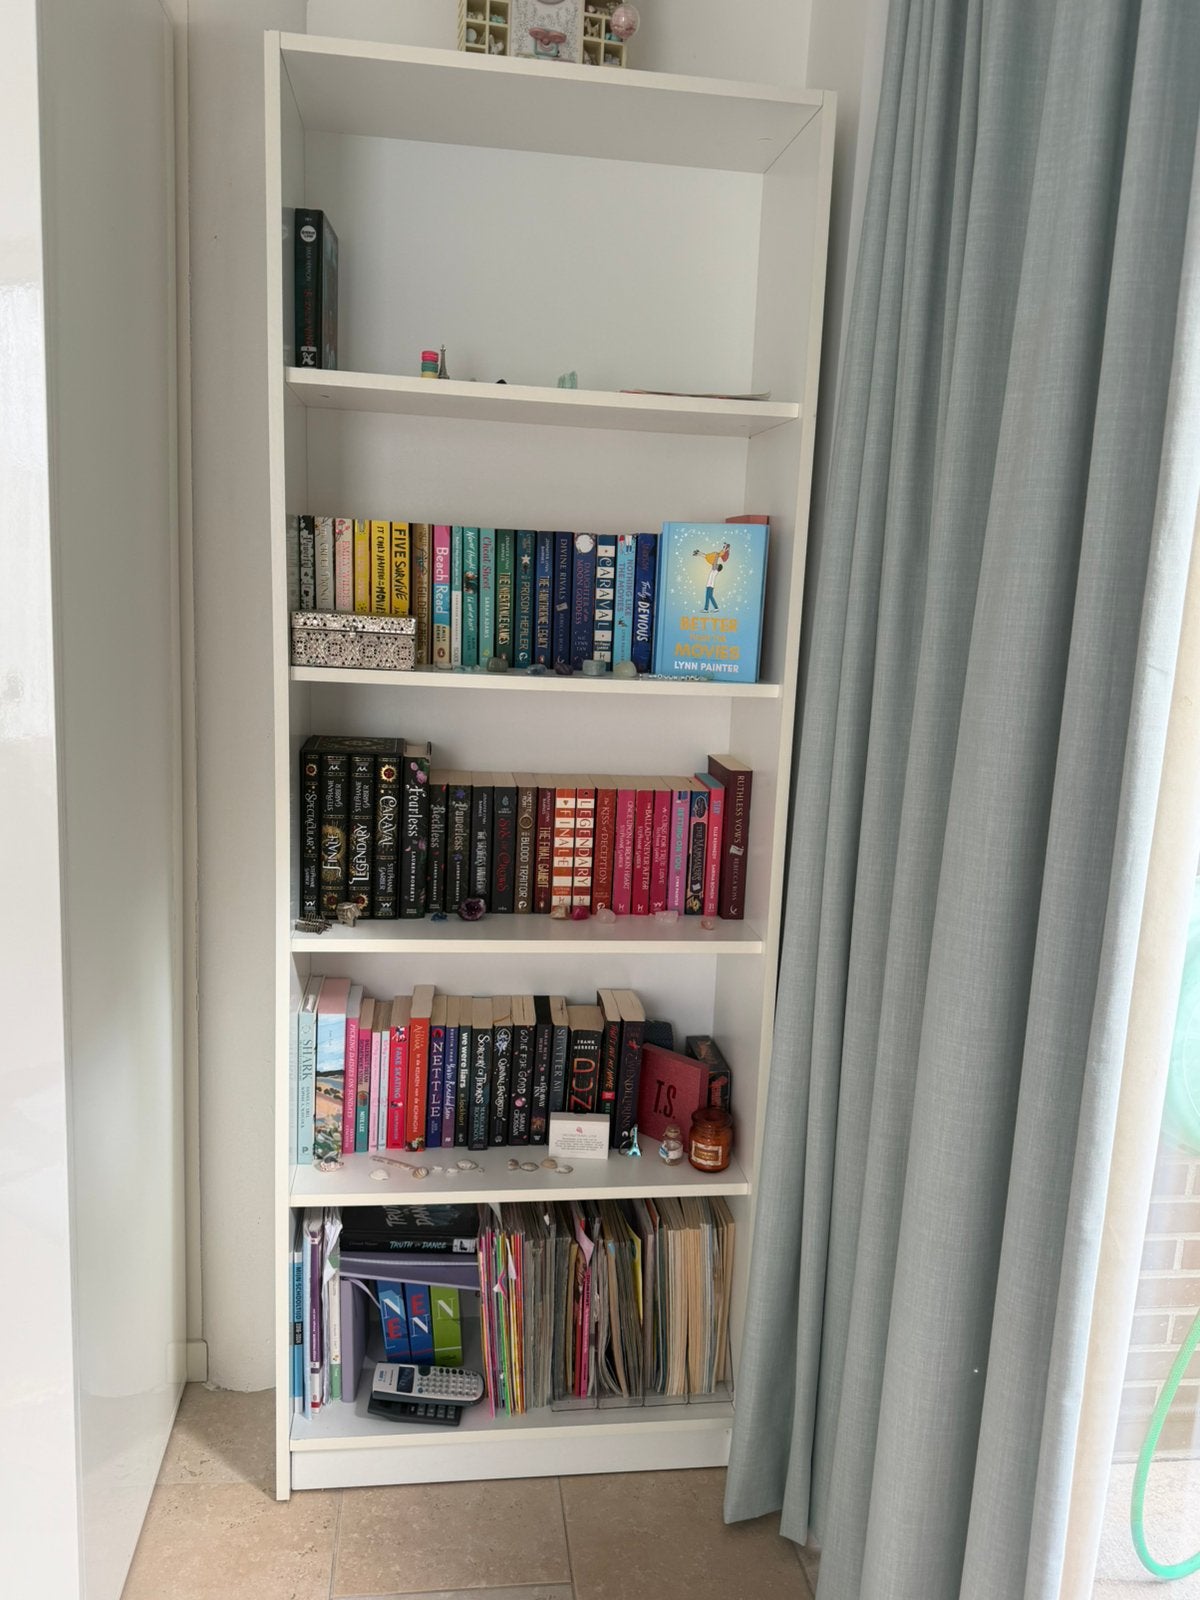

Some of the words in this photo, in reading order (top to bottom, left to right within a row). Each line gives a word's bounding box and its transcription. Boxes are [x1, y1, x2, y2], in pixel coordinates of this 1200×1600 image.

[342, 541, 350, 567] EMILY
[394, 529, 406, 558] FIVE
[482, 536, 492, 561] Cheat
[436, 547, 449, 581] Beach
[394, 561, 408, 600] SURVIVE
[482, 566, 491, 590] Sheet
[499, 572, 511, 583] THE
[539, 576, 550, 587] THE
[559, 572, 567, 599] RIVALS
[436, 585, 449, 613] Read
[520, 581, 530, 614] PRISON
[597, 558, 612, 629] CARAVAL
[638, 581, 650, 600] Truly
[575, 588, 583, 624] GODDESS
[519, 616, 530, 649] HEALER
[637, 601, 650, 642] DEVIOUS
[680, 616, 738, 632] BETTER
[499, 624, 510, 645] GAMES
[538, 625, 548, 649] LEGACY
[675, 643, 740, 660] MOVIES
[674, 661, 698, 670] LYNN
[700, 662, 739, 673] PAINTER
[736, 775, 745, 816] RUTHLESS
[305, 793, 318, 846] SPECTACULAR
[378, 796, 397, 846] CARAVAL
[406, 784, 425, 837] Fearless
[601, 806, 610, 824] KISS
[676, 807, 685, 839] BETTING
[431, 804, 446, 848] Reckless
[452, 801, 469, 850] Powerless
[539, 827, 551, 839] THE
[659, 815, 667, 834] CURSE
[734, 819, 742, 843] VOWS
[520, 837, 530, 862] BLOOD
[558, 810, 572, 866] FINALE
[578, 800, 592, 886] LEGENDARY
[676, 840, 683, 852] ON
[322, 834, 341, 877] FINALE
[349, 824, 370, 884] LEGENDARY
[538, 841, 551, 861] FINAL
[599, 833, 609, 884] DECEPTION
[643, 840, 651, 865] NEVER
[675, 853, 683, 871] YOU
[379, 867, 387, 891] GARBER
[387, 863, 395, 892] STEPHANIE
[519, 865, 529, 898] TRAITOR
[538, 863, 550, 888] GAMBIT
[623, 870, 631, 890] HEART
[642, 867, 650, 890] AFTER
[658, 868, 666, 884] LOVE
[462, 1032, 469, 1045] we
[520, 1029, 529, 1051] GONE
[302, 1039, 313, 1080] SHARK
[476, 1034, 490, 1069] SORCERY
[520, 1054, 528, 1067] FOR
[554, 1029, 566, 1076] SHATTER
[348, 1079, 355, 1088] ON
[395, 1067, 403, 1098] SKATING
[431, 1042, 444, 1117] NETTLE
[460, 1069, 469, 1088] liars
[475, 1074, 487, 1104] THORNS
[518, 1071, 527, 1094] GOOD
[607, 1069, 616, 1089] NAME
[653, 1079, 677, 1120] T.S.
[390, 1241, 414, 1249] TRUTH
[411, 1294, 426, 1316] E
[437, 1298, 455, 1320] N
[387, 1317, 402, 1339] E
[410, 1314, 430, 1337] N
